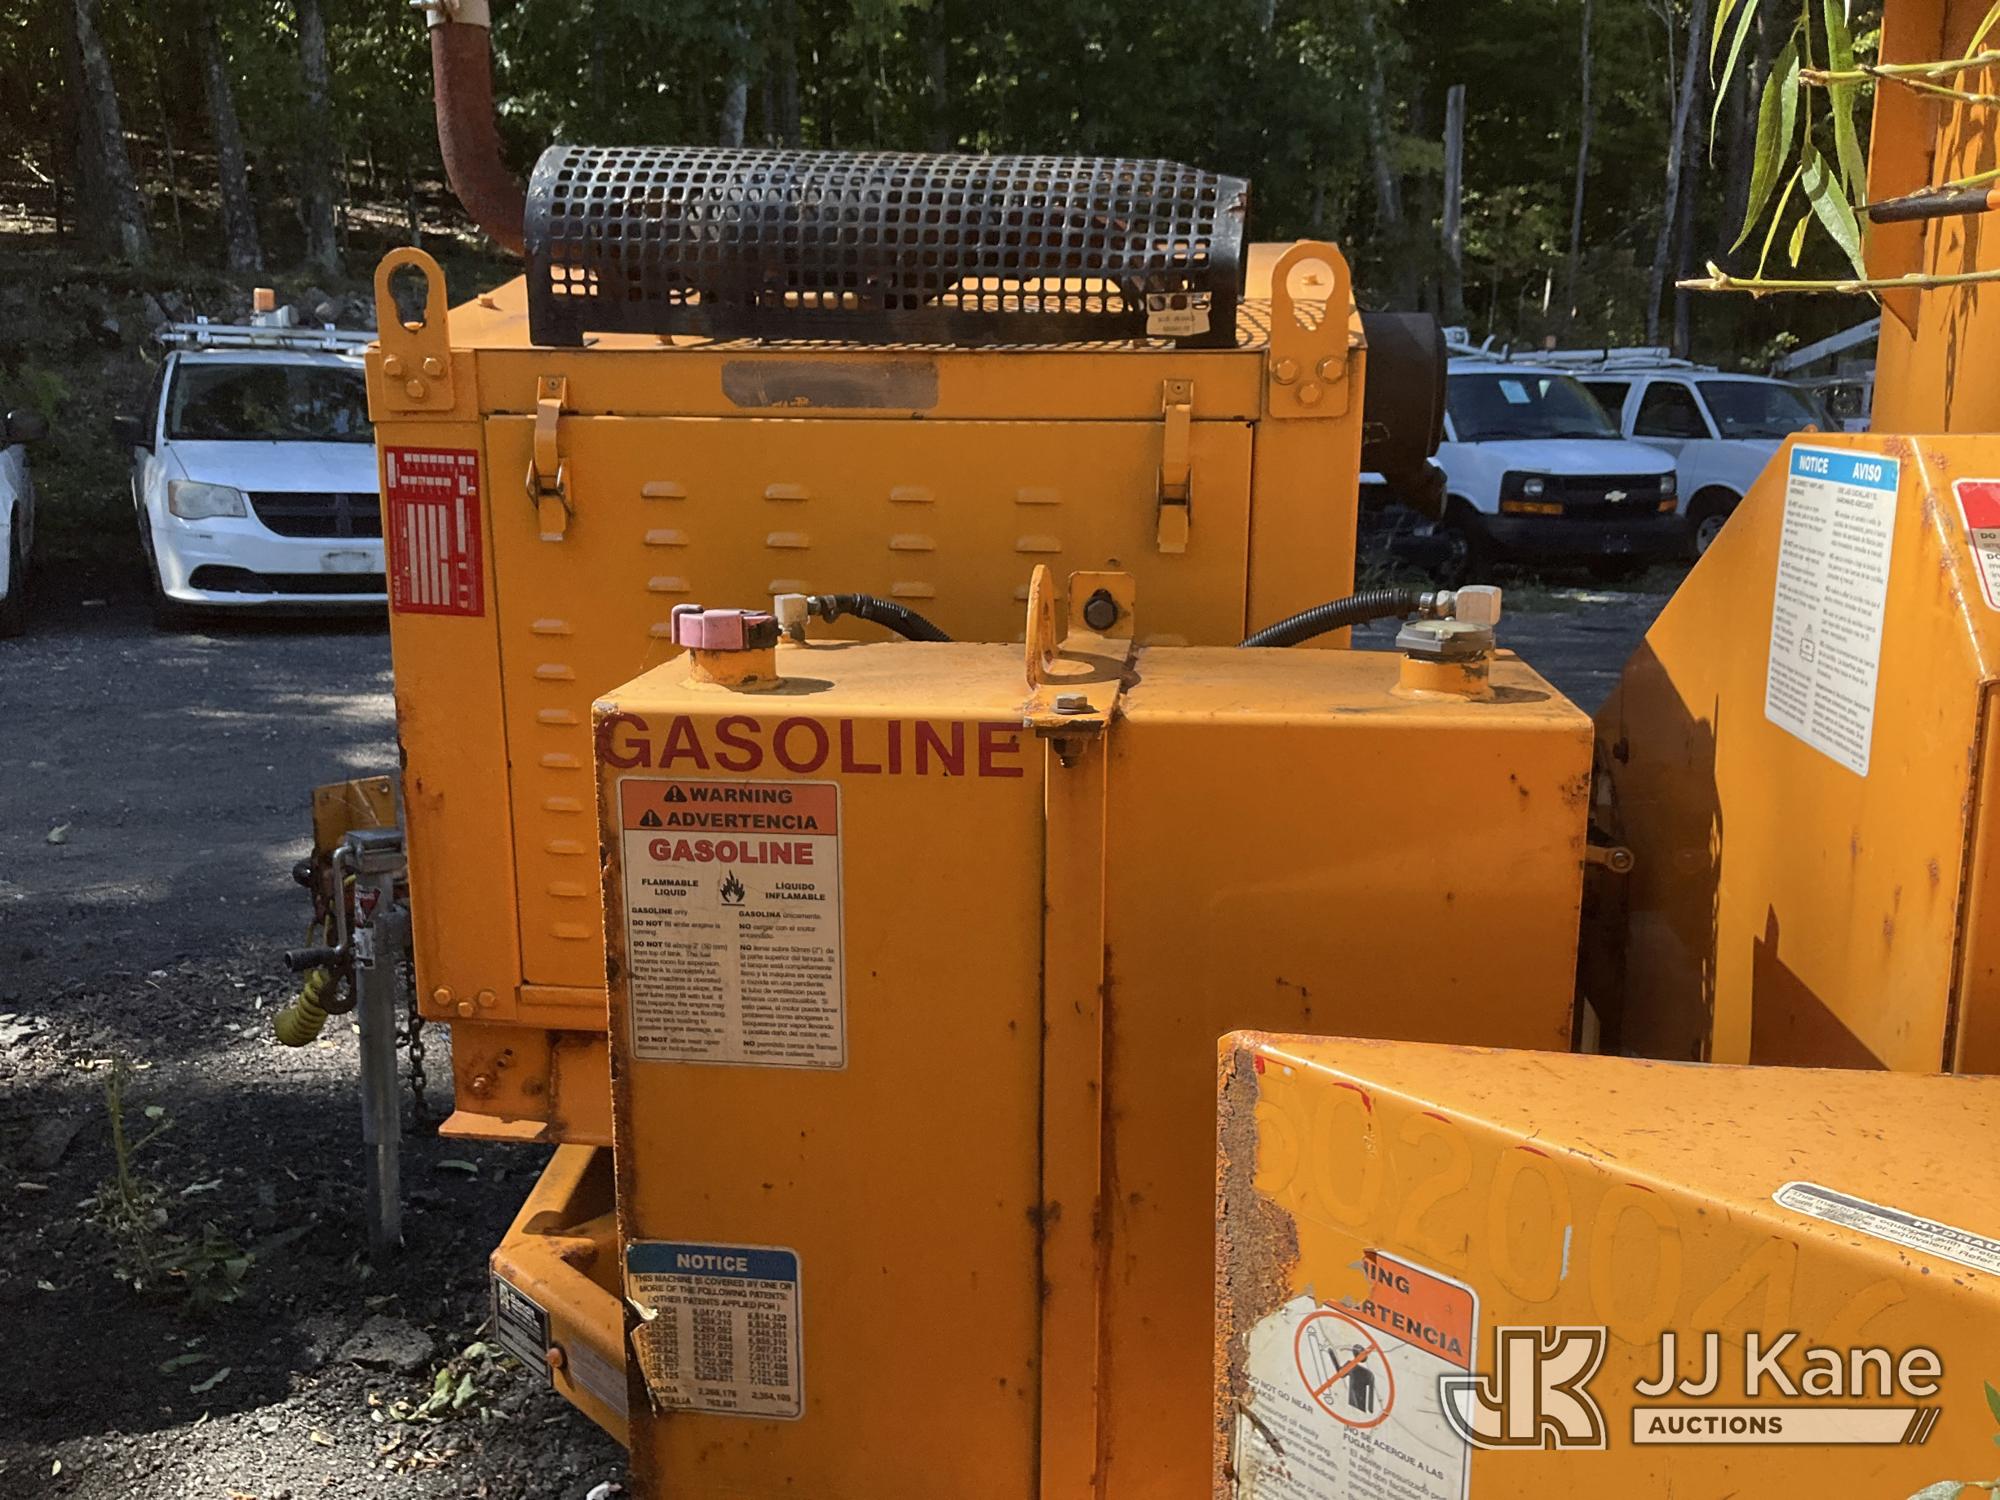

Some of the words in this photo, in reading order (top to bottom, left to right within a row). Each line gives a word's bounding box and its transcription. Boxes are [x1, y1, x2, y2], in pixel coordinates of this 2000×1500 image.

[1799, 455, 1829, 474] NOTICE
[1853, 461, 1882, 482] AVISO
[600, 713, 1025, 778] GASOLINE
[690, 787, 793, 804] WARNING
[667, 812, 819, 830] ADVERTENCIA
[649, 838, 814, 865] GASOLINE
[642, 879, 698, 887] FLAMMABLE
[766, 892, 825, 900] INFLAMABLE
[677, 1254, 748, 1272] NOTICE
[704, 1277, 745, 1287] COVERED
[1373, 1440, 1416, 1466] ACERQUE
[1418, 1462, 1424, 1471] A
[1426, 1465, 1444, 1480] LAS
